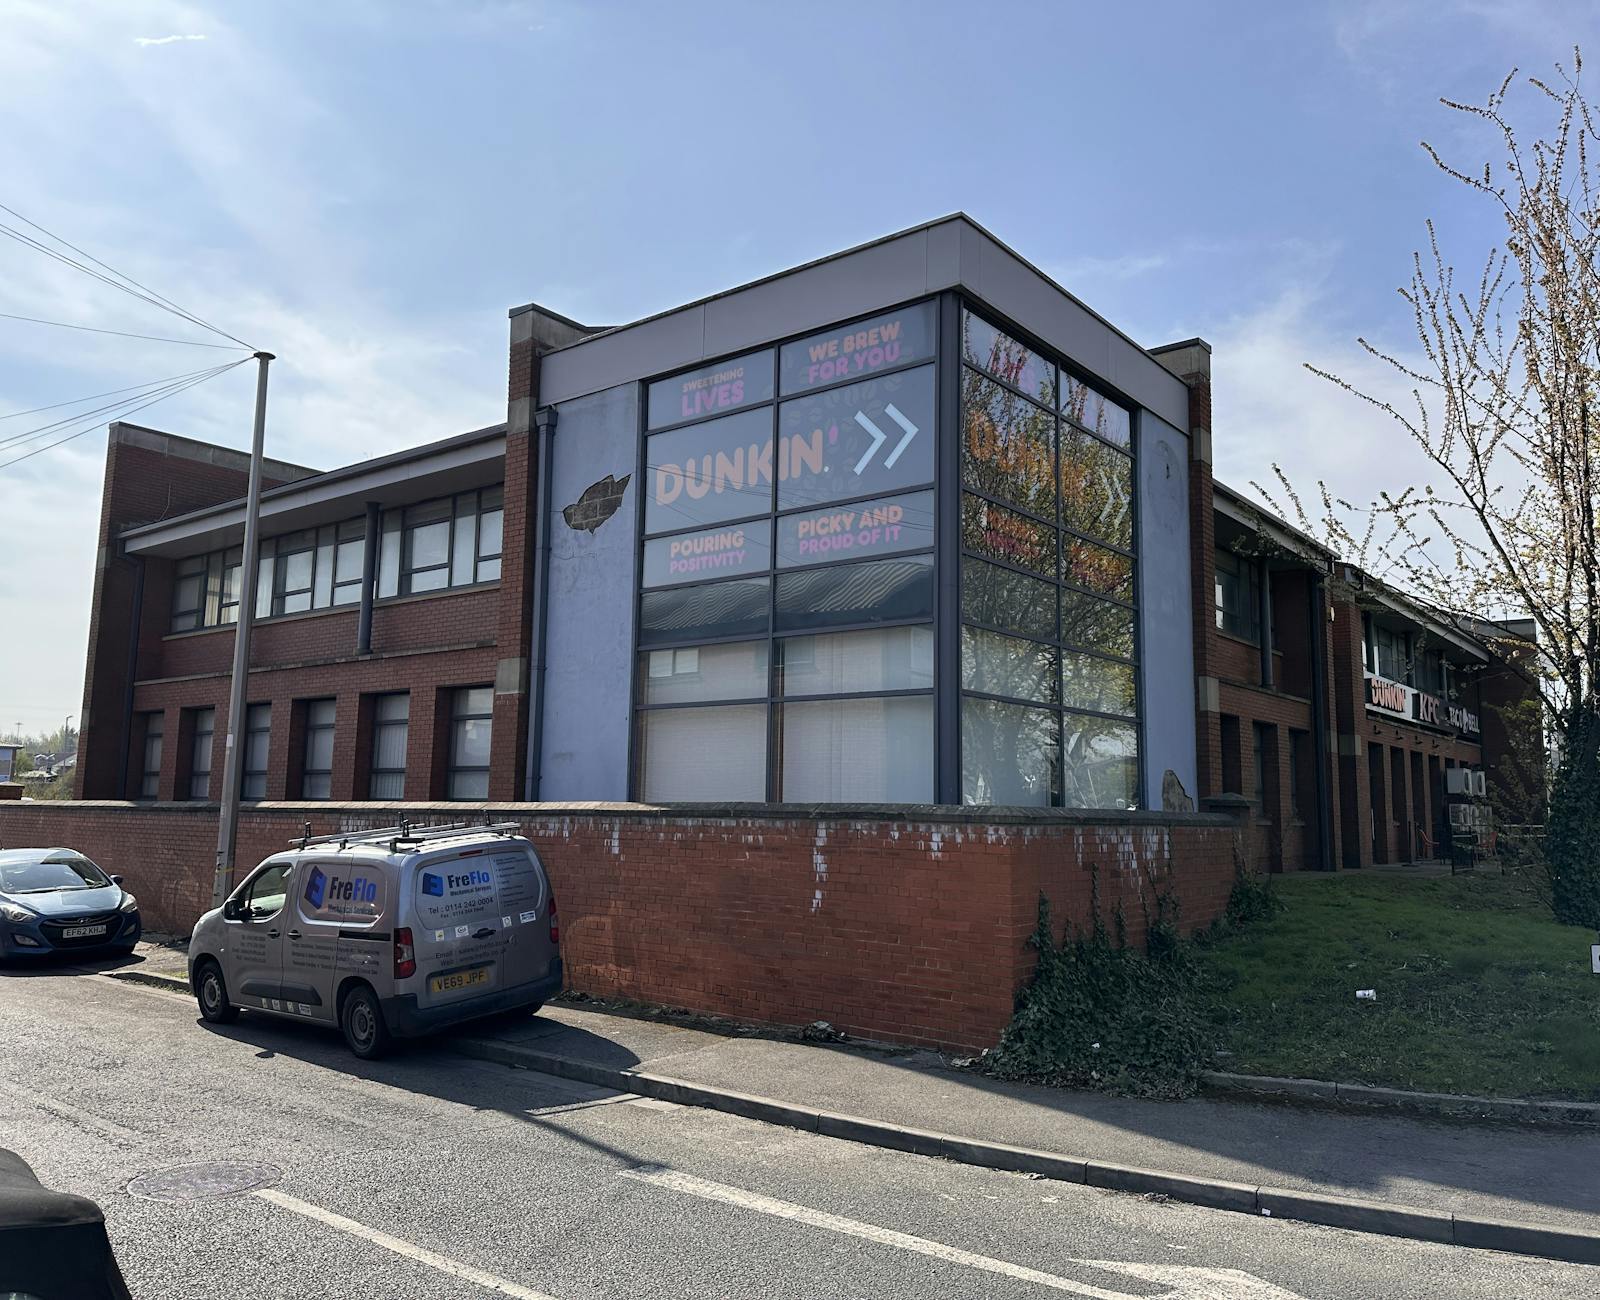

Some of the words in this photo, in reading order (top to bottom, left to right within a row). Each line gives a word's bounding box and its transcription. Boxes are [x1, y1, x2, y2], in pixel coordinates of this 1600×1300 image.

[808, 339, 838, 363] WE
[843, 321, 901, 354] BREW
[807, 359, 849, 385] FOR
[855, 341, 902, 370] YOU
[682, 367, 744, 393] SWEETENING
[681, 380, 745, 417] LIVES
[798, 511, 856, 538] PICKY
[859, 505, 904, 530] AND
[670, 530, 745, 558] POURING
[799, 532, 854, 555] PROUD
[858, 528, 881, 546] OF
[885, 524, 902, 543] IT
[669, 550, 746, 574] POSITIVITY
[1419, 692, 1441, 725] KFC
[328, 876, 377, 903] FreFlo
[447, 870, 490, 888] FreFlo
[428, 906, 439, 914] Tel
[445, 902, 463, 911] 0114
[463, 899, 476, 909] 242
[66, 927, 87, 937] EF62
[88, 925, 104, 935] KHJ
[437, 975, 463, 990] VE69
[466, 971, 485, 984] JPF
